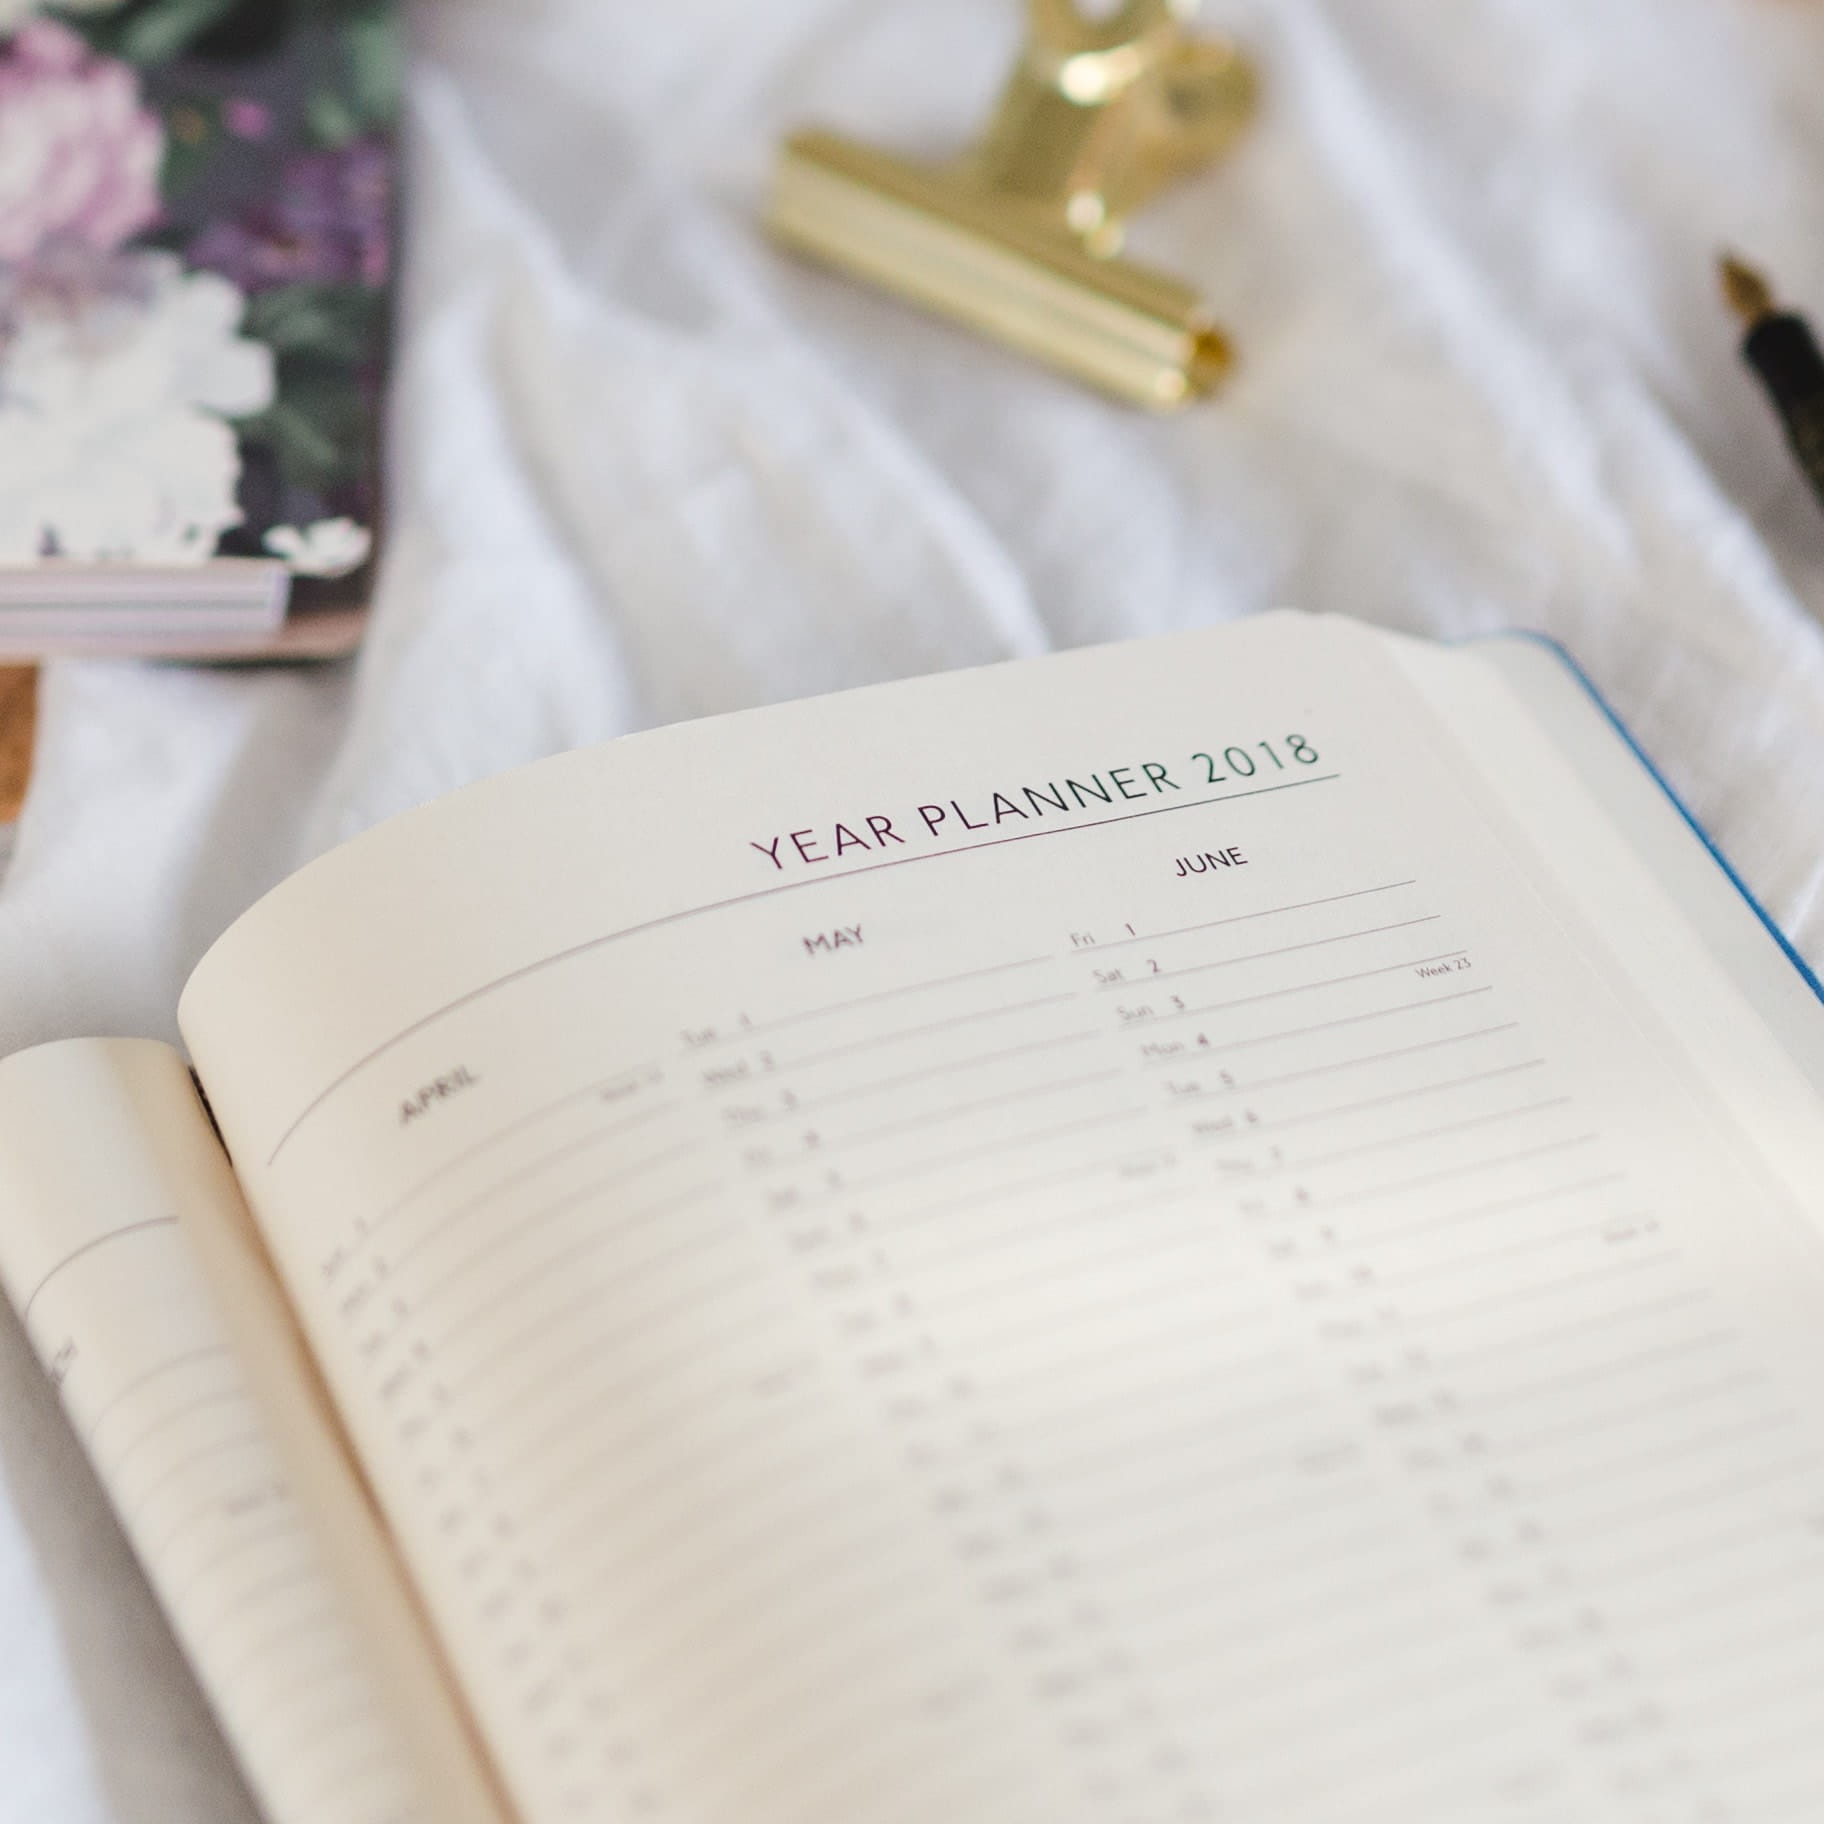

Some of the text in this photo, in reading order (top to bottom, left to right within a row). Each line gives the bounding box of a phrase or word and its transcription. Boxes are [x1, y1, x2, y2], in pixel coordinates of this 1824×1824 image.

[750, 732, 1321, 872] YEAR PLANNER 2018
[1174, 845, 1250, 879] JUNE
[802, 922, 866, 958] MAY
[1069, 922, 1137, 948] Fri 1
[1092, 958, 1162, 985] Sat 2
[1415, 956, 1473, 980] Week 23
[1116, 1003, 1155, 1022] Sun
[398, 1064, 482, 1128] APRIL
